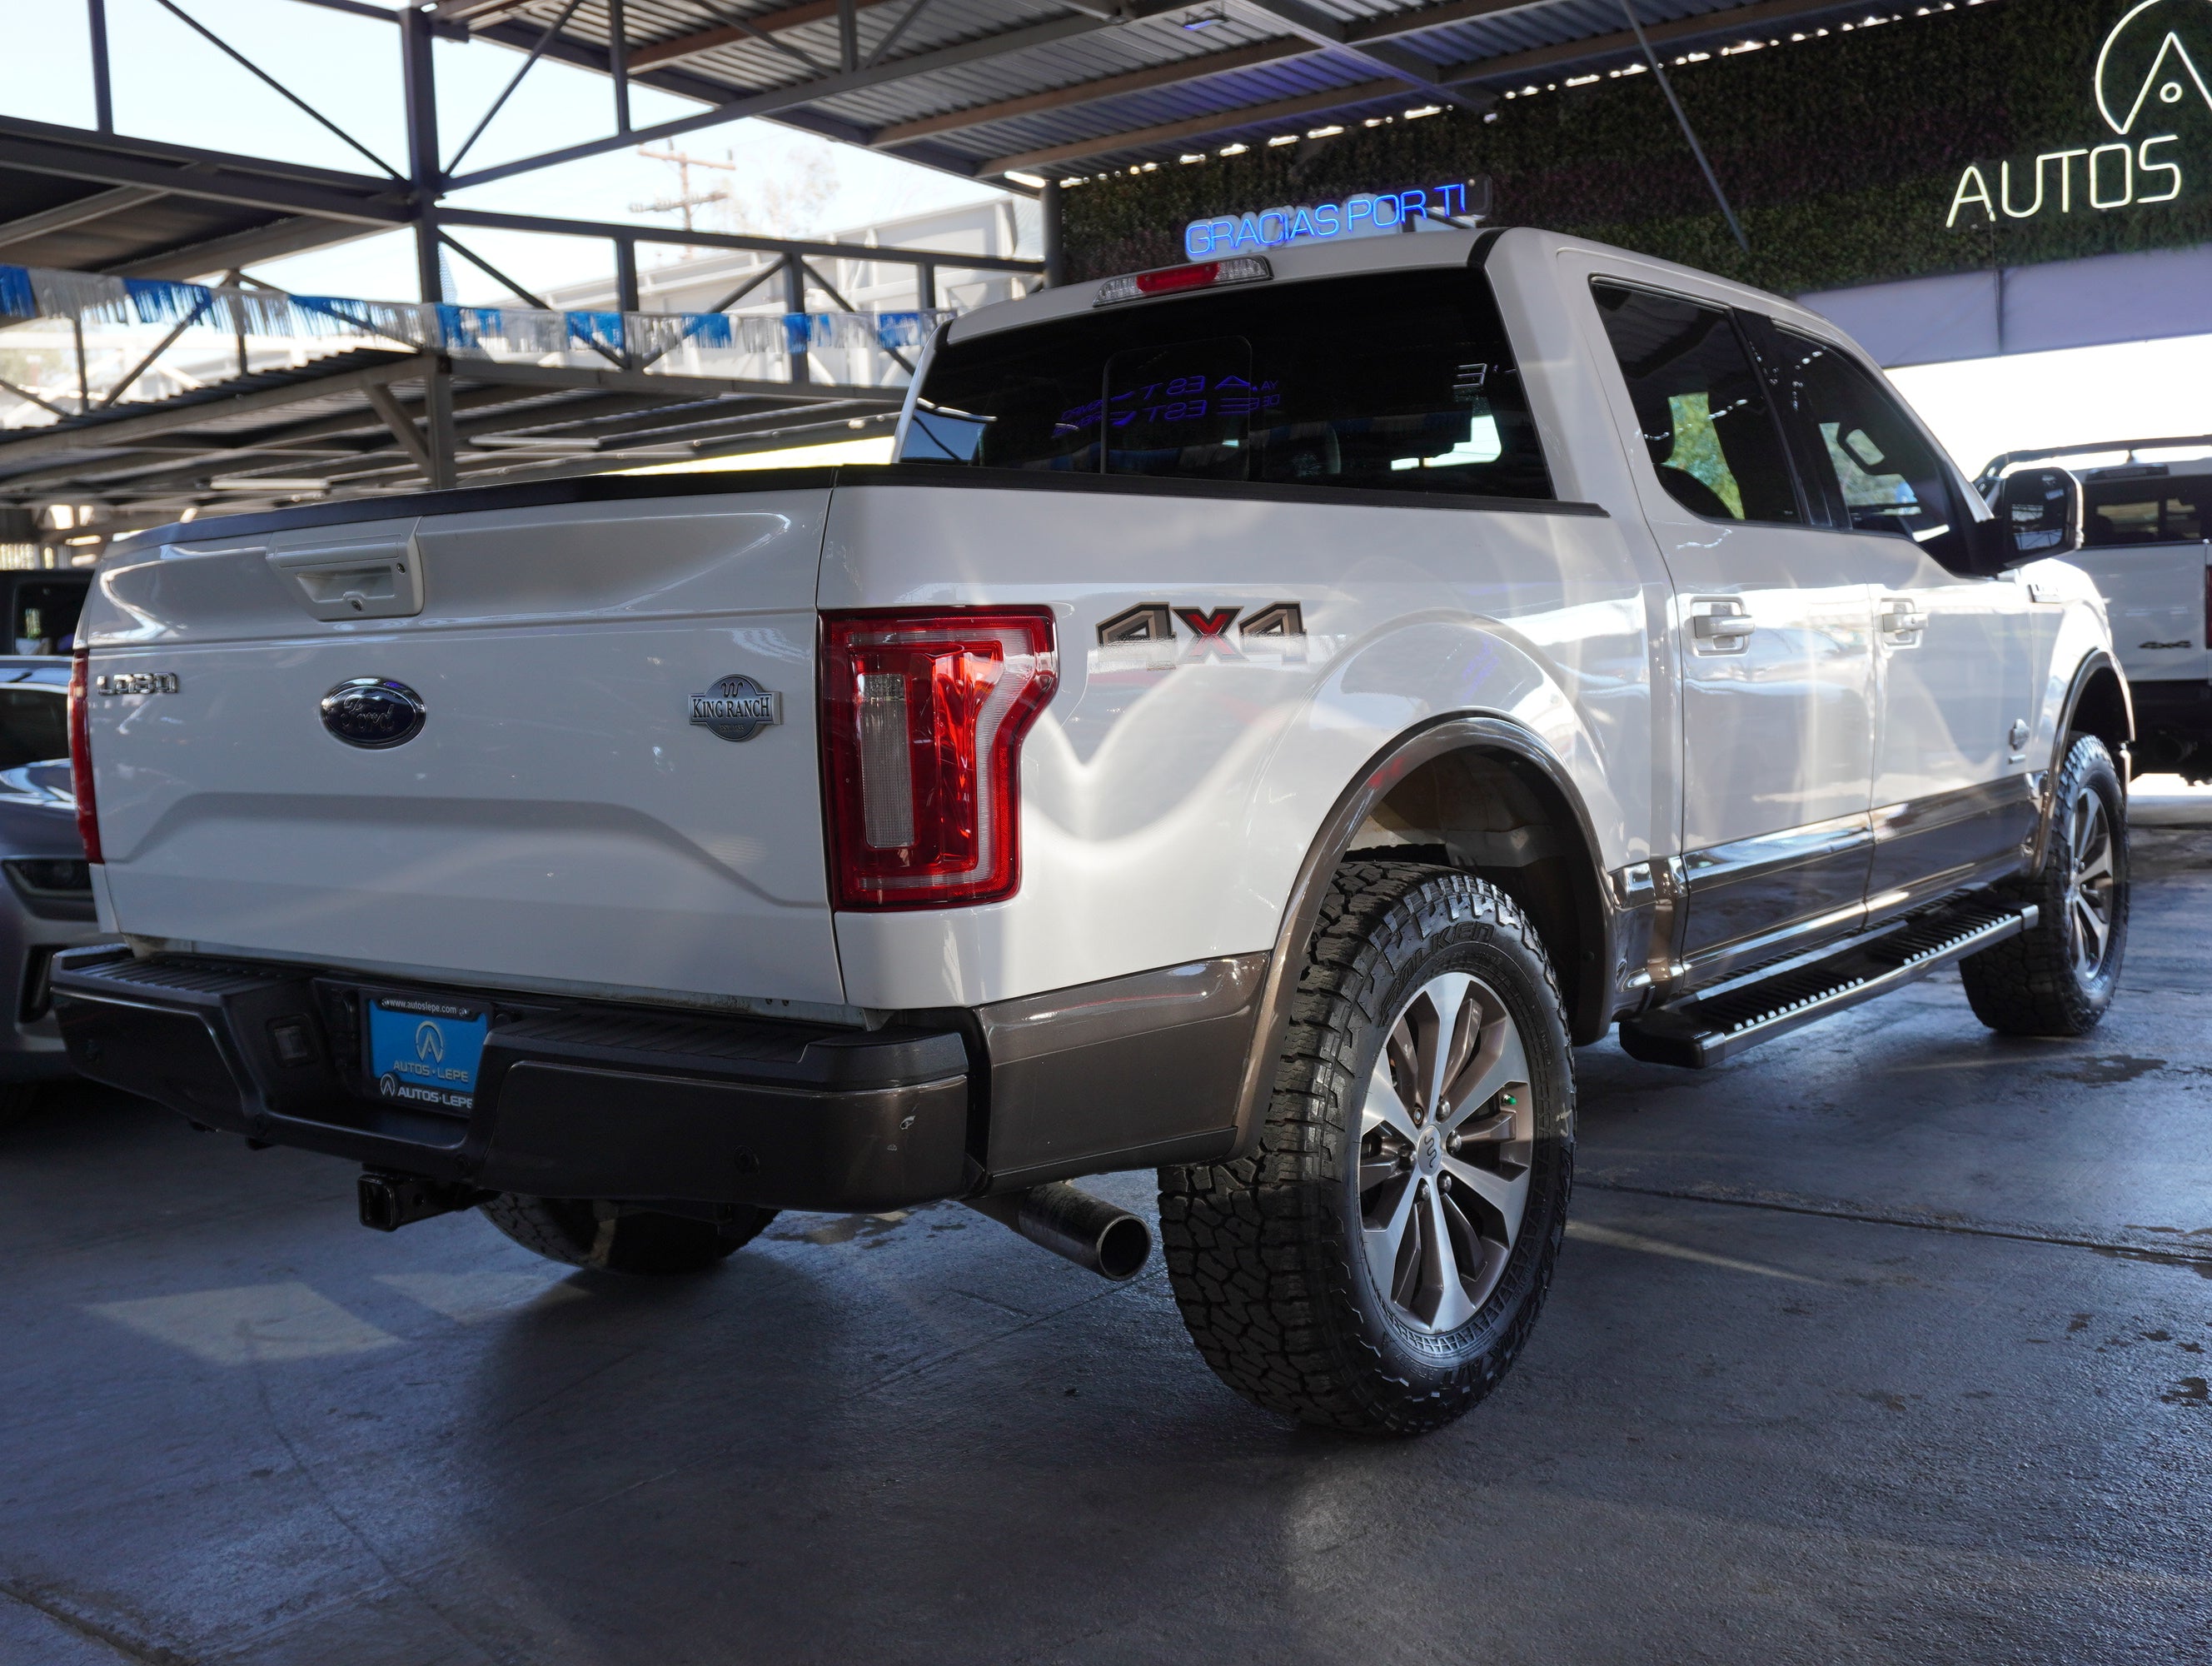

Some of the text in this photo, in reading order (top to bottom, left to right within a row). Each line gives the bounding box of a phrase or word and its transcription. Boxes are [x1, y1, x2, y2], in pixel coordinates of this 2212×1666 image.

[1945, 135, 2182, 228] AUTOS
[1185, 183, 1467, 256] GRACIAS POR TI
[693, 696, 770, 718] KING RANCH
[388, 999, 457, 1015] www.autoslepe.com
